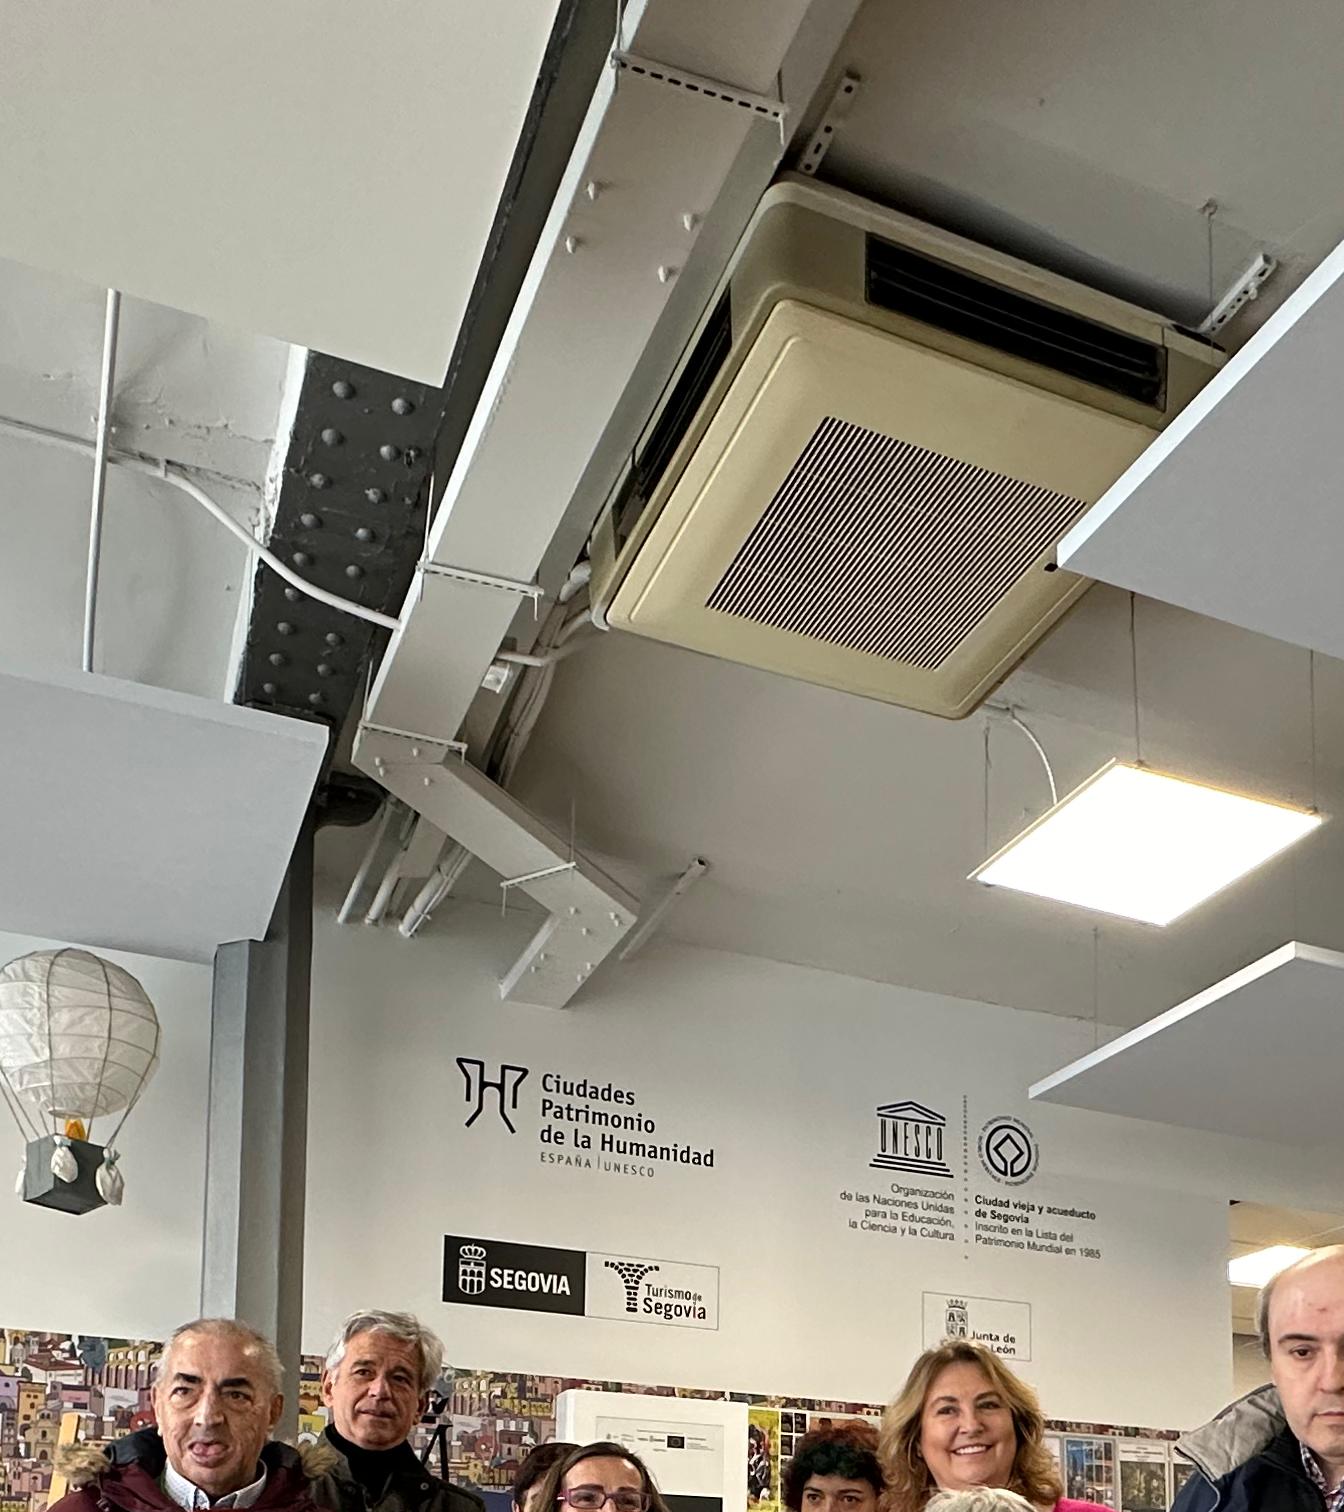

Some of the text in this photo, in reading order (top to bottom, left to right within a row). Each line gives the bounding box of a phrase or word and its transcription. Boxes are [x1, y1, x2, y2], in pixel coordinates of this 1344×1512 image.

[542, 1073, 636, 1106] Ciudades
[541, 1098, 656, 1134] Patrimonio
[540, 1125, 715, 1168] de la Humanidad
[880, 1118, 943, 1161] UNESCO
[540, 1151, 655, 1178] ESPAÑA UNESCO
[839, 1190, 955, 1214] de las Naciones Unidas
[890, 1183, 955, 1201] Organización
[864, 1209, 887, 1219] para
[890, 1210, 899, 1221] la
[974, 1194, 1096, 1221] Ciudad vieja y acueducto
[974, 1208, 1030, 1224] de Segovia
[848, 1218, 955, 1241] la Ciencia y la Cultura
[1011, 1227, 1023, 1236] en
[1025, 1226, 1033, 1237] la
[1036, 1228, 1057, 1241] Lista
[1059, 1232, 1074, 1243] del
[975, 1234, 1101, 1260] Patrimonio Mundial en 1985
[489, 1267, 571, 1297] SEGOVIA
[645, 1283, 692, 1302] Turismo
[642, 1297, 707, 1322] Segovia
[970, 1330, 1016, 1344] Junta de
